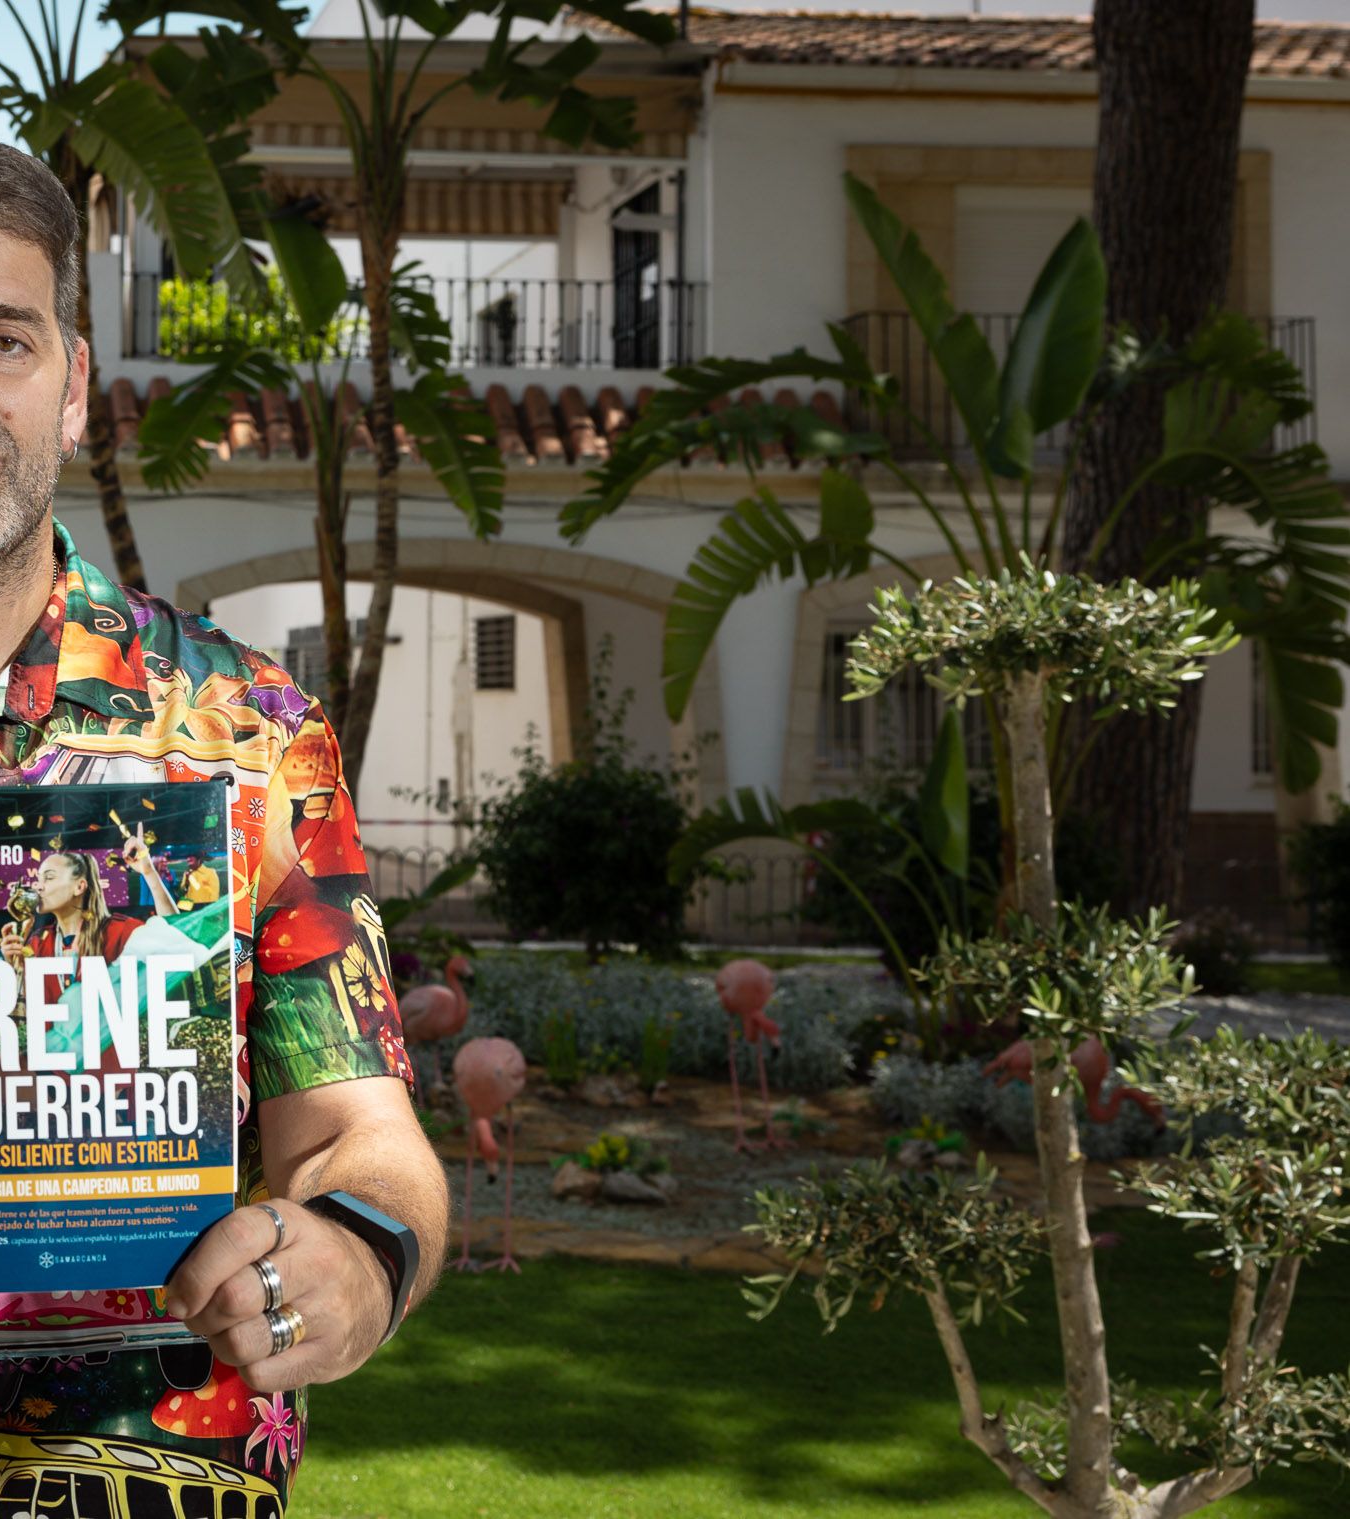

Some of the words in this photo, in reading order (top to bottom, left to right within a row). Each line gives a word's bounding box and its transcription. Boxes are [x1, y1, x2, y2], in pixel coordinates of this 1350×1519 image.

[78, 1141, 112, 1165] CON
[116, 1139, 199, 1164] ESTRELLA
[16, 1180, 32, 1197] DE
[35, 1178, 61, 1196] UNA
[63, 1176, 129, 1196] CAMPEONA
[131, 1176, 154, 1193] DEL
[157, 1174, 199, 1192] MUNDO
[28, 1209, 38, 1218] de
[39, 1208, 50, 1218] las
[51, 1209, 65, 1219] que
[66, 1208, 107, 1217] transmiten
[134, 1204, 174, 1214] motivación
[23, 1220, 35, 1229] de
[36, 1219, 64, 1229] luchar
[65, 1218, 88, 1228] hasta
[90, 1217, 125, 1227] alcanzar
[126, 1218, 141, 1226] sus
